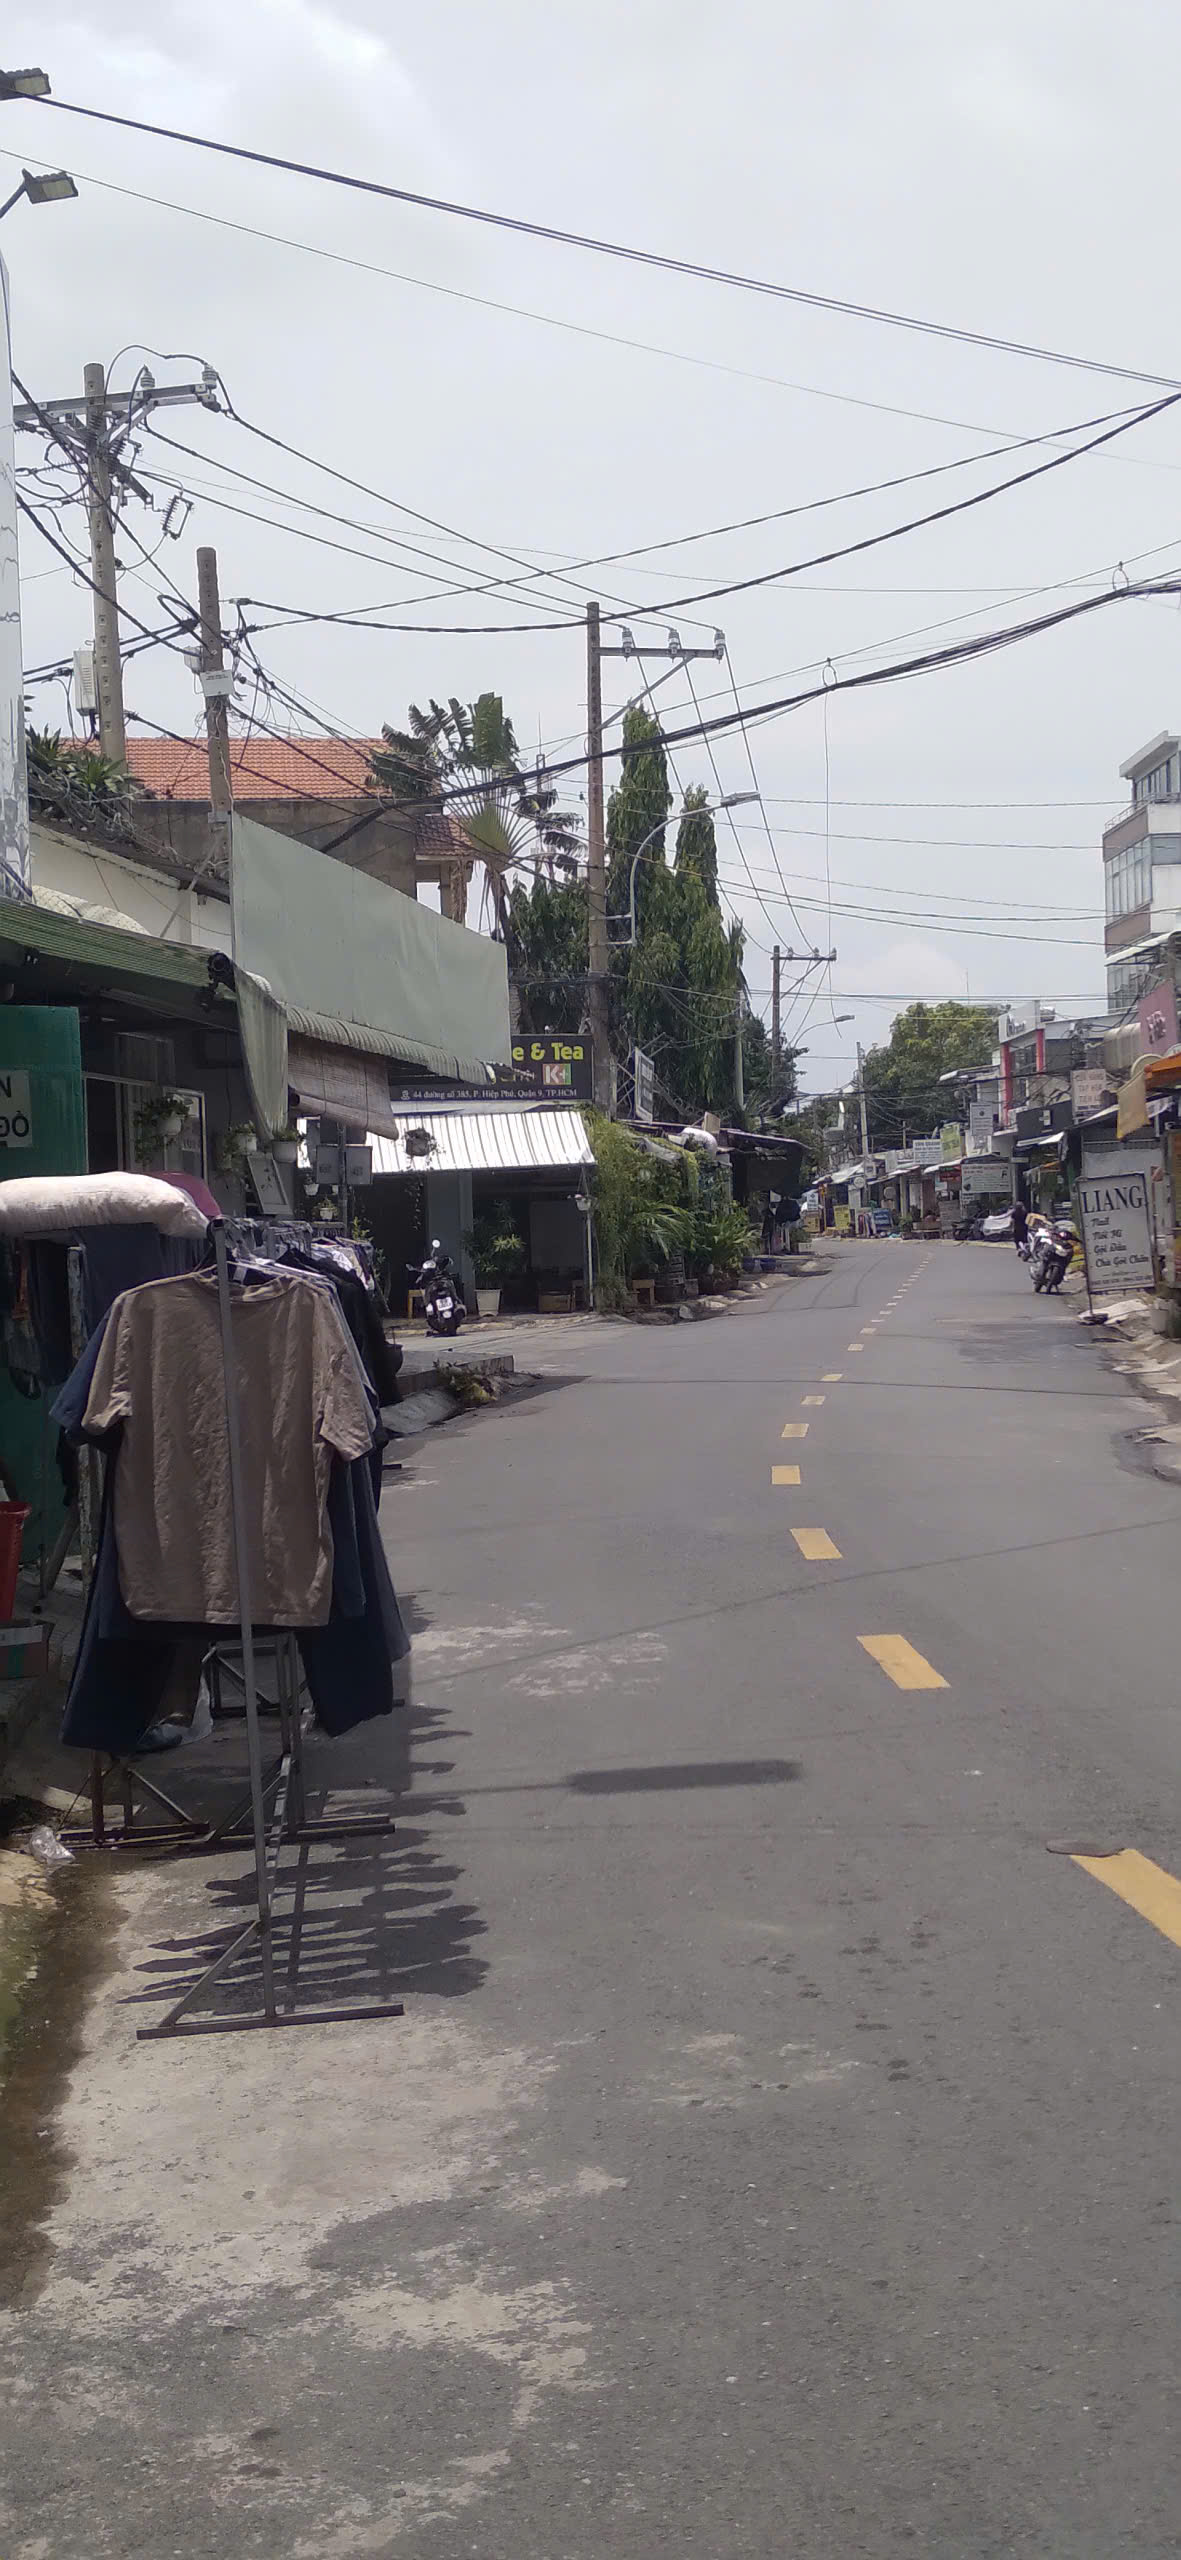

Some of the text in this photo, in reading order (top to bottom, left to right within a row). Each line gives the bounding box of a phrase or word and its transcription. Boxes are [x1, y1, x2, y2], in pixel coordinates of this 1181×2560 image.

[531, 1043, 545, 1060] &
[551, 1042, 584, 1060] Tea
[546, 1088, 577, 1097] TP.HCM
[1081, 1185, 1144, 1213] LIANG
